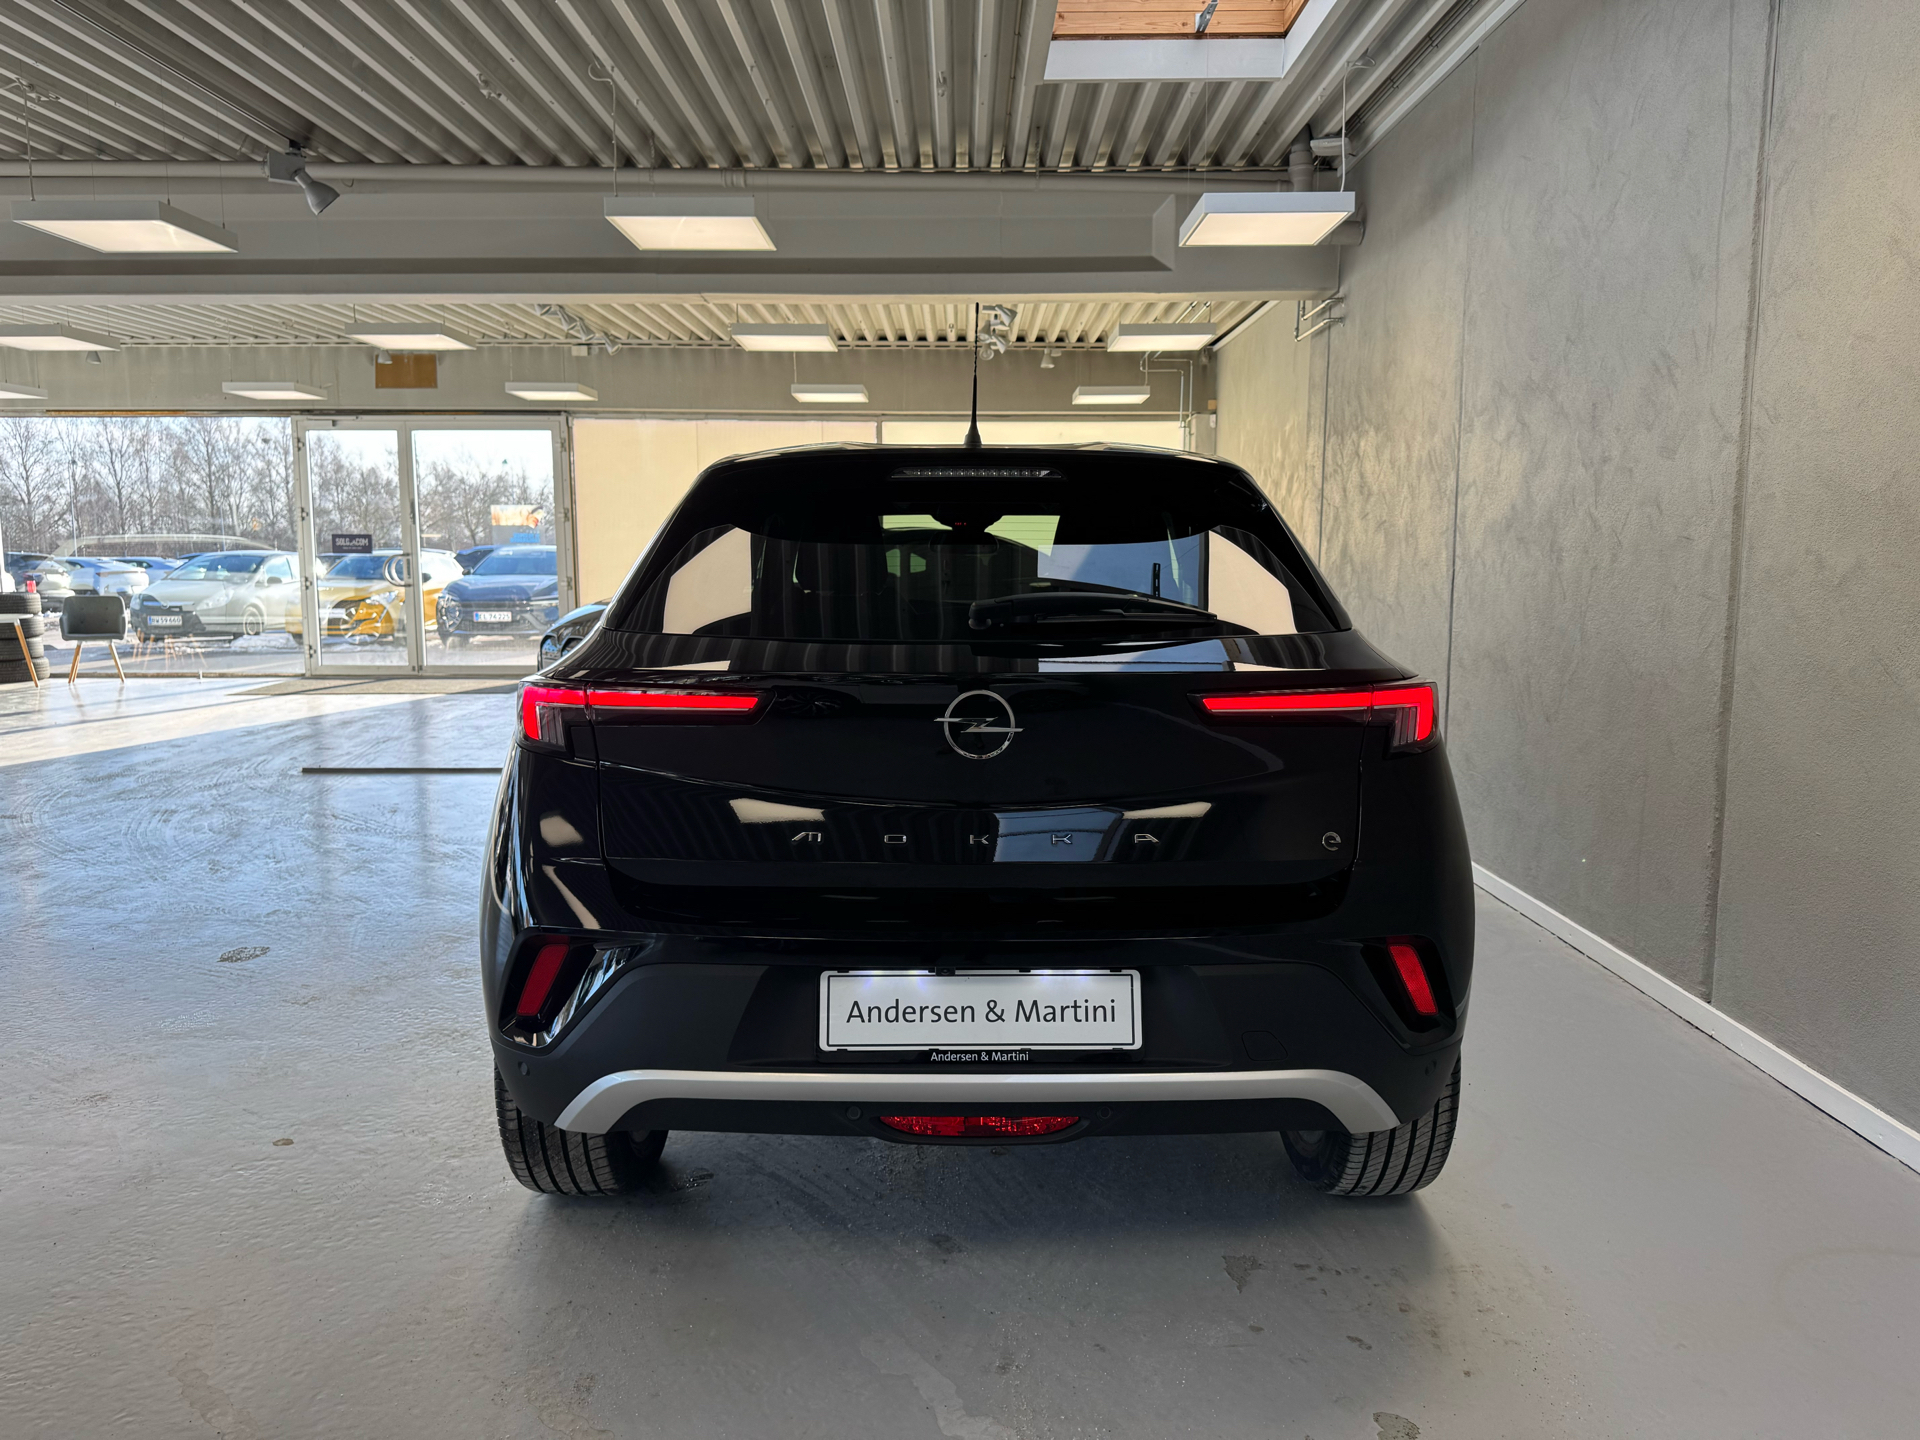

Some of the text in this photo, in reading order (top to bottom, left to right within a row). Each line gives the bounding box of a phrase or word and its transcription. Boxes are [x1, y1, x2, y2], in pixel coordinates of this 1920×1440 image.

[791, 831, 1160, 845] MOKKA
[846, 998, 1117, 1023] Andersen & Martini
[930, 1051, 1029, 1062] Andersen & Martini
